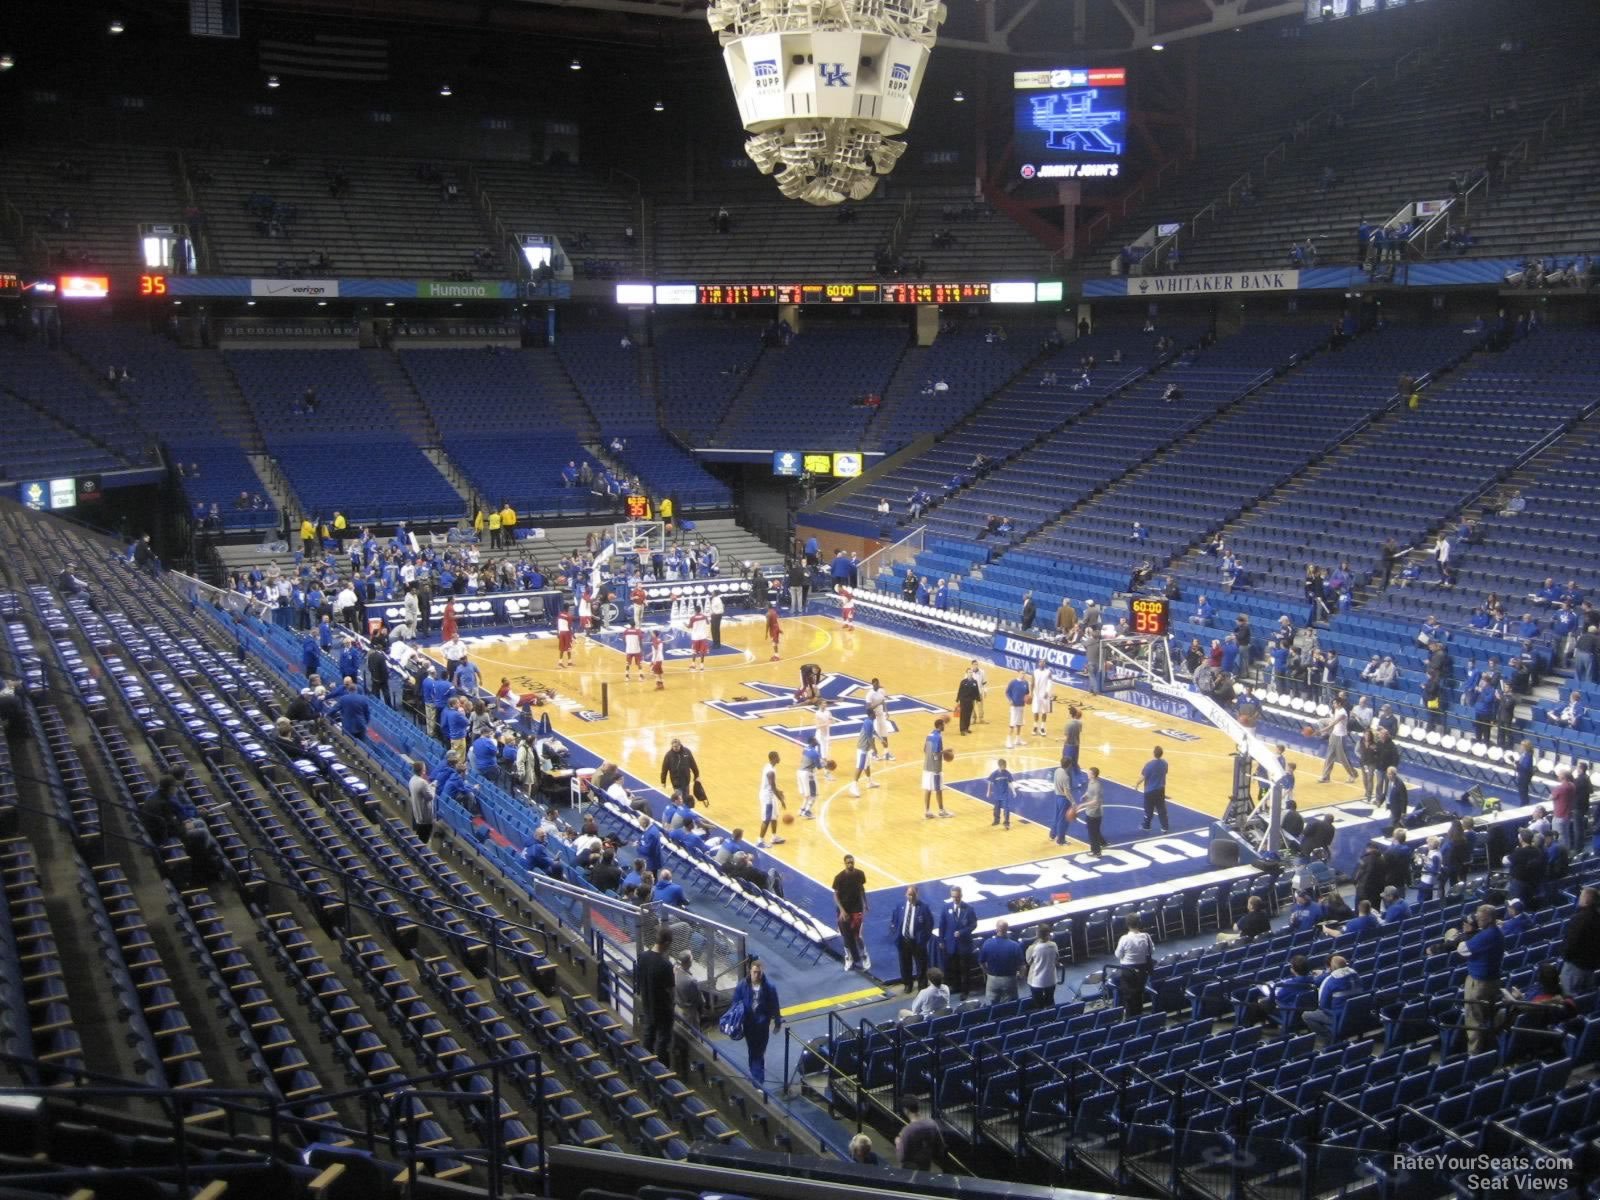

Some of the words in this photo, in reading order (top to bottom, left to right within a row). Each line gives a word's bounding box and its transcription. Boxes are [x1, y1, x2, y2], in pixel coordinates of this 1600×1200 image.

[818, 63, 851, 87] UK
[756, 78, 780, 88] RUPP
[888, 80, 908, 91] RUPP
[141, 276, 166, 295] 35
[1154, 275, 1234, 292] WHITAKER
[1241, 273, 1285, 288] BANK
[292, 285, 325, 295] verizon
[430, 283, 485, 297] Humana
[631, 505, 643, 515] 35
[1133, 600, 1162, 614] 60:00
[1136, 612, 1158, 632] 35
[1004, 637, 1075, 668] KENTUCKY
